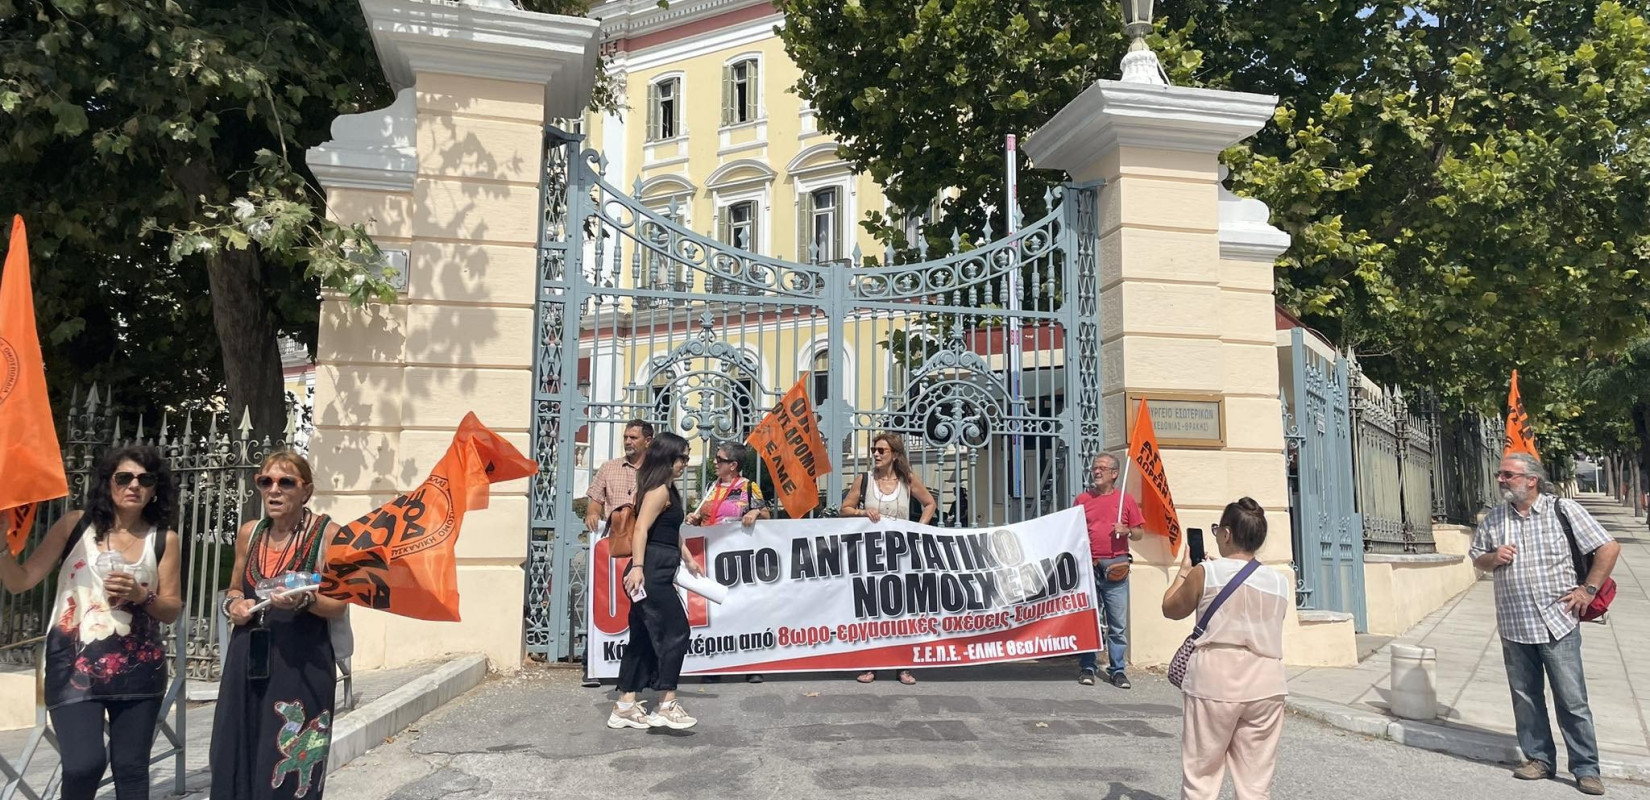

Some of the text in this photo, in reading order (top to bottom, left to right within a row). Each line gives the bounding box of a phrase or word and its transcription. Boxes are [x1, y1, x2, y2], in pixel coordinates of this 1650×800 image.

[1154, 421, 1209, 432] ΚΕΔΟΝΙΑΣ-ΘΡΑΚΗΣ
[1175, 408, 1214, 420] ΕΣΩΤΕΡΙΚΩΝ
[1136, 456, 1168, 498] ΔΩΡΕΑΝ
[714, 547, 780, 587] στο
[790, 529, 1024, 580] ΑΝΤΕΡΓΑΤΙΚΟ
[853, 551, 1079, 618] ΝΟΜΟΣΧΕΔΙΟ
[739, 628, 774, 650] από
[778, 614, 938, 646] 8ωρο-εργασιακές
[913, 645, 962, 663] Σ.Ε.Π.Ε.
